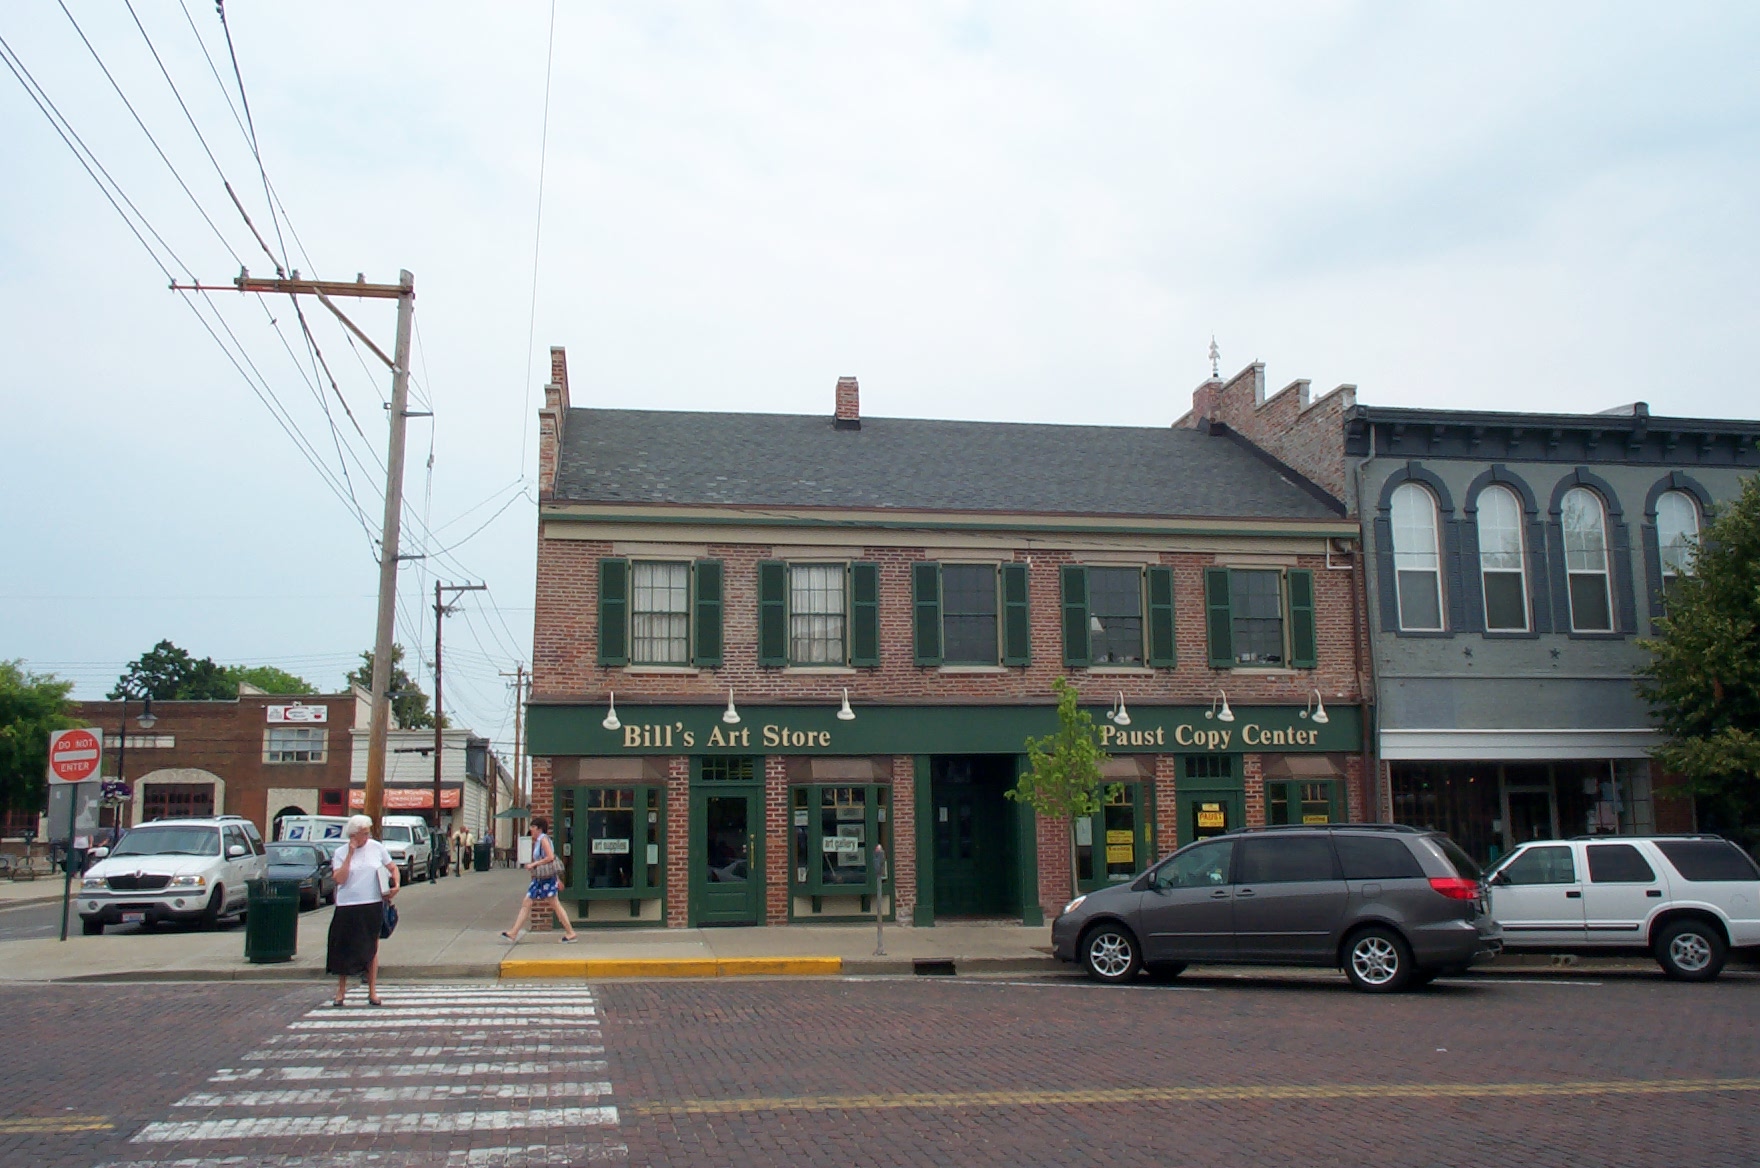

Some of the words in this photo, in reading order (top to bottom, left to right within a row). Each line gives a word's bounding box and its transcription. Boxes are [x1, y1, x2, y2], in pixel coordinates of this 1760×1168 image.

[622, 722, 695, 747] Bill's
[706, 725, 750, 747] Art
[763, 724, 831, 747] Store
[1101, 724, 1165, 746] Paust
[1175, 724, 1232, 750] Copy
[1242, 723, 1318, 746] Center
[58, 741, 71, 750] DO
[76, 739, 93, 748] NOT
[61, 762, 89, 772] ENTER
